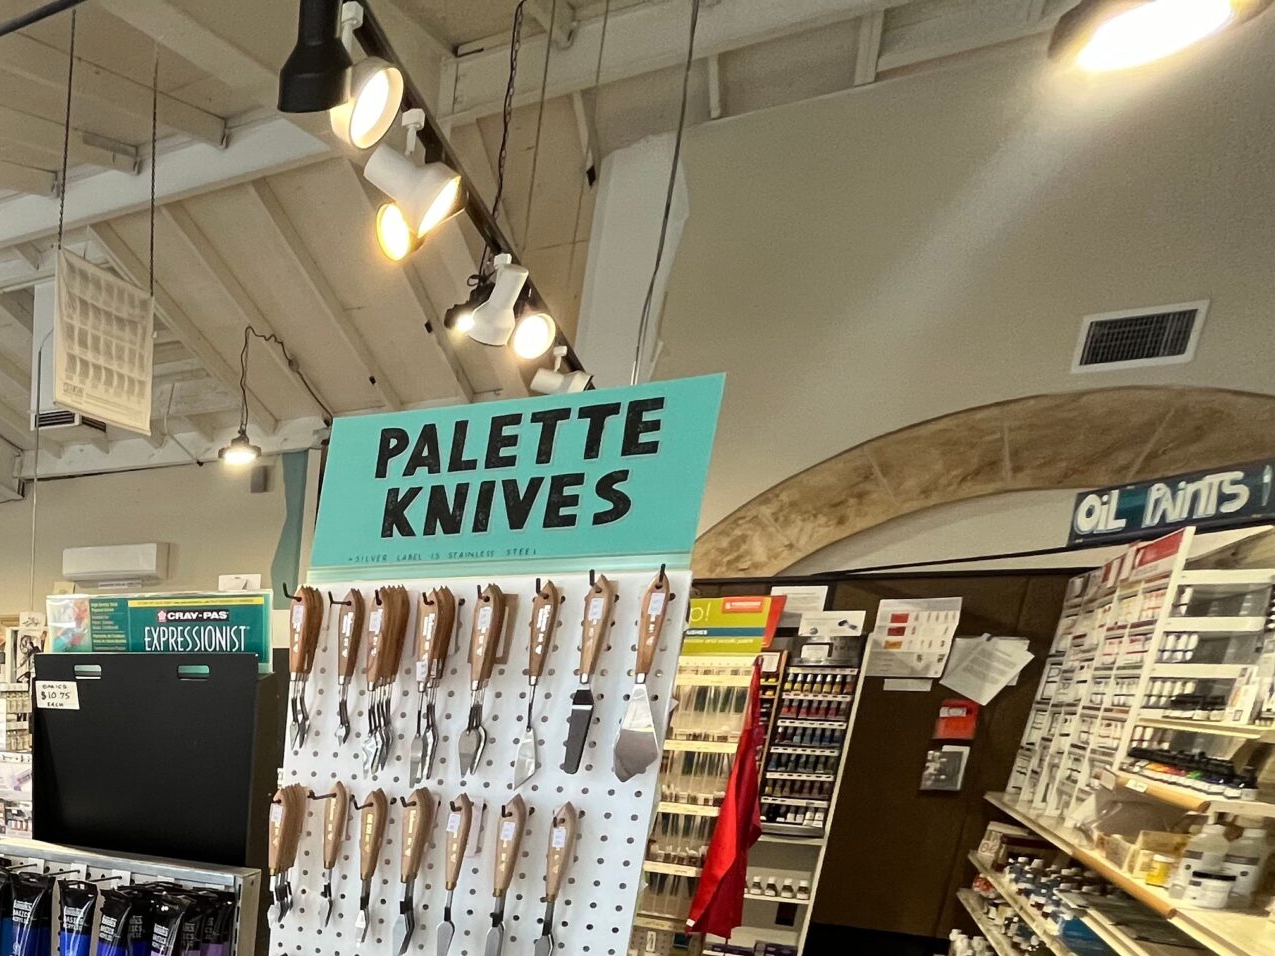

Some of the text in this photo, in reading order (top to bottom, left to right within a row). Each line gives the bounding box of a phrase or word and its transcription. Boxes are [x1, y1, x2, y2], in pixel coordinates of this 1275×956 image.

[374, 396, 666, 479] PALETTE
[379, 469, 633, 539] KNIVES
[396, 552, 423, 562] LABEL
[448, 549, 495, 559] STAINLESS
[166, 610, 228, 620] CRAY-PAS
[143, 625, 246, 652] EXPRESSIONIST
